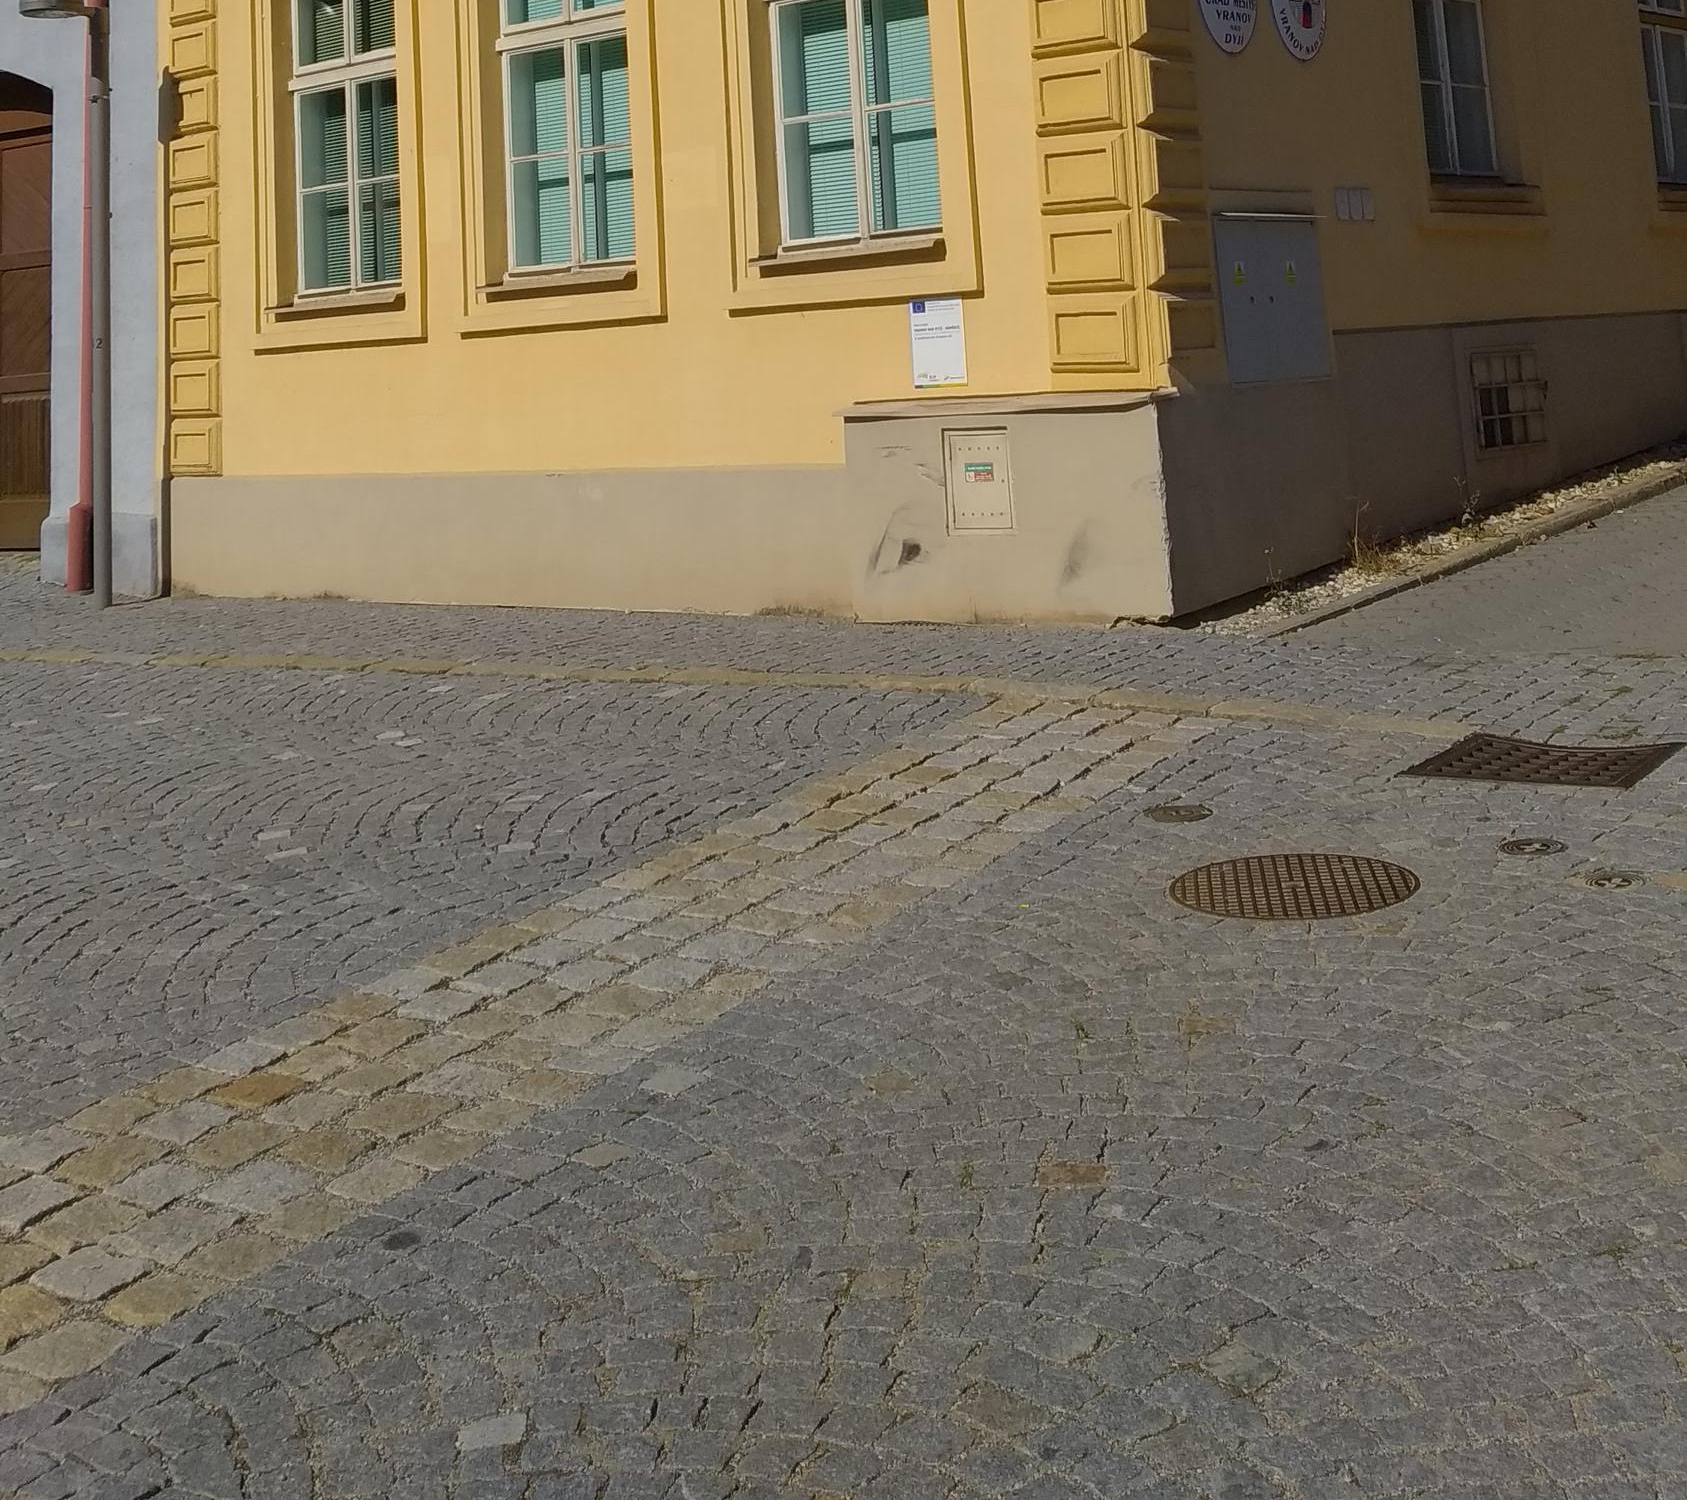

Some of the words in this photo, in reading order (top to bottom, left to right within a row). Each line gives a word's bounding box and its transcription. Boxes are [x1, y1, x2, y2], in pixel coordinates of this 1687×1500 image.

[1216, 9, 1251, 23] VRANOV
[1280, 8, 1304, 51] VRANOV
[95, 337, 103, 349] 2
